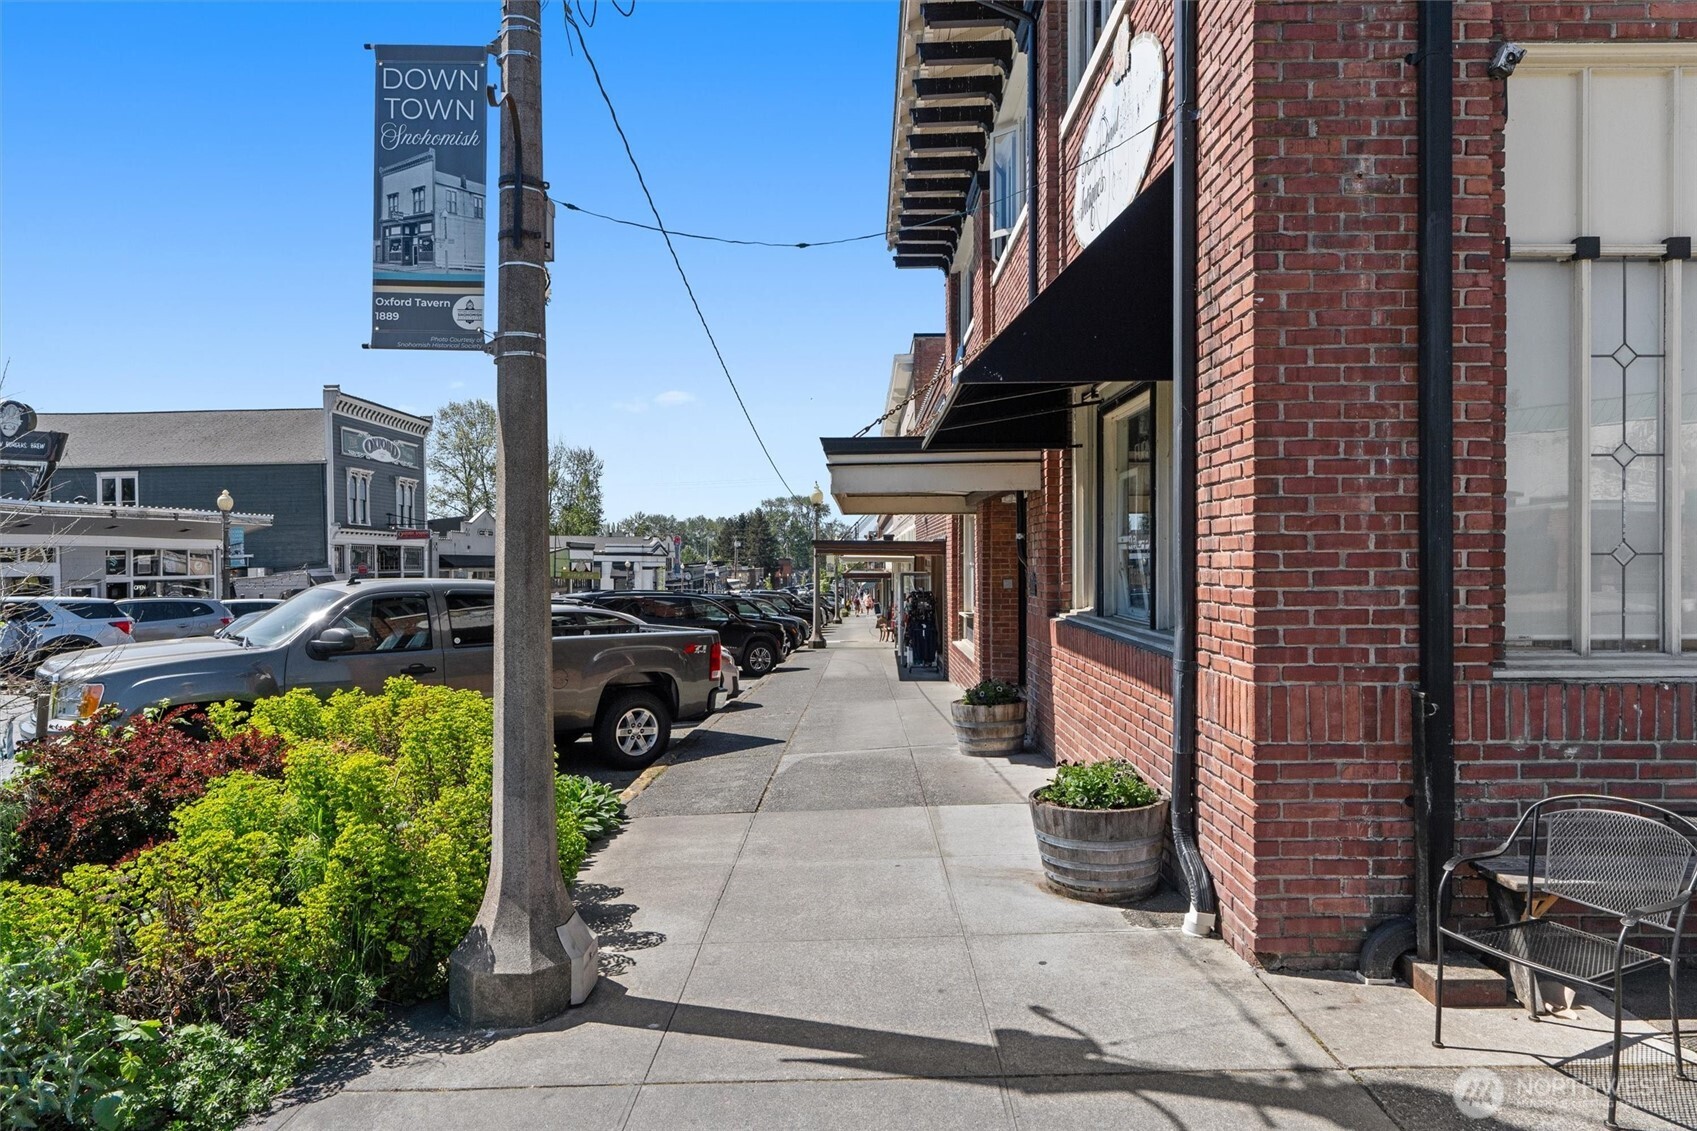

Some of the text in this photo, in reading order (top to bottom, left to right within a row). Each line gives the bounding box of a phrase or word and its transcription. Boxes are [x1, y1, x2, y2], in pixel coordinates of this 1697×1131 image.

[383, 67, 478, 91] DOWN
[383, 97, 474, 121] TOWN
[380, 122, 481, 150] Snohomish
[375, 297, 451, 307] Oxford Tavern
[375, 311, 400, 320] 1889
[449, 336, 476, 344] Courtesy
[364, 437, 399, 459] OXFORD
